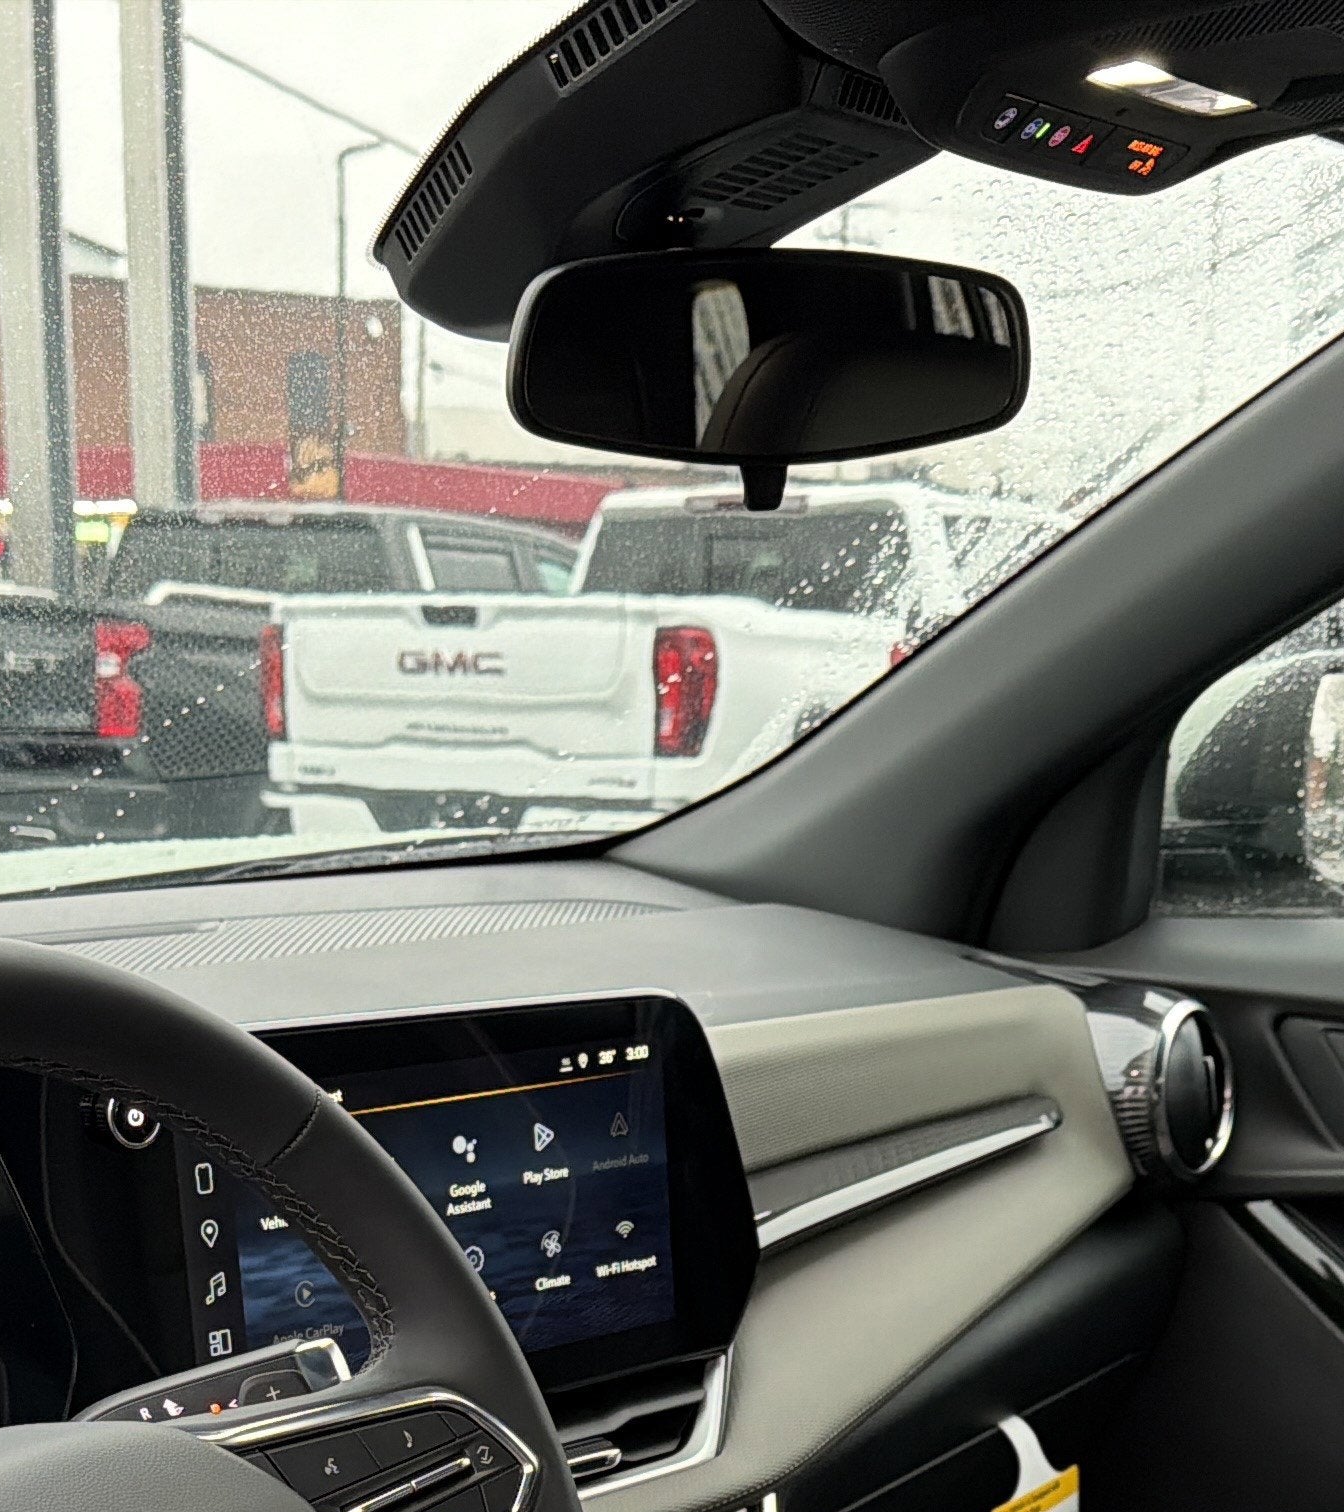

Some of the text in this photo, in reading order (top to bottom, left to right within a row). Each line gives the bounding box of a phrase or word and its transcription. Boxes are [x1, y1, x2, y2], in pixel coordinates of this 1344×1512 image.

[397, 650, 507, 677] GMC
[592, 1152, 650, 1172] Android Auto
[522, 1167, 570, 1186] Play Store
[449, 1180, 487, 1199] Google
[446, 1197, 492, 1217] Assistant
[621, 1254, 657, 1275] Hotspot
[535, 1274, 571, 1292] Climate
[306, 1322, 344, 1340] CarPlay
